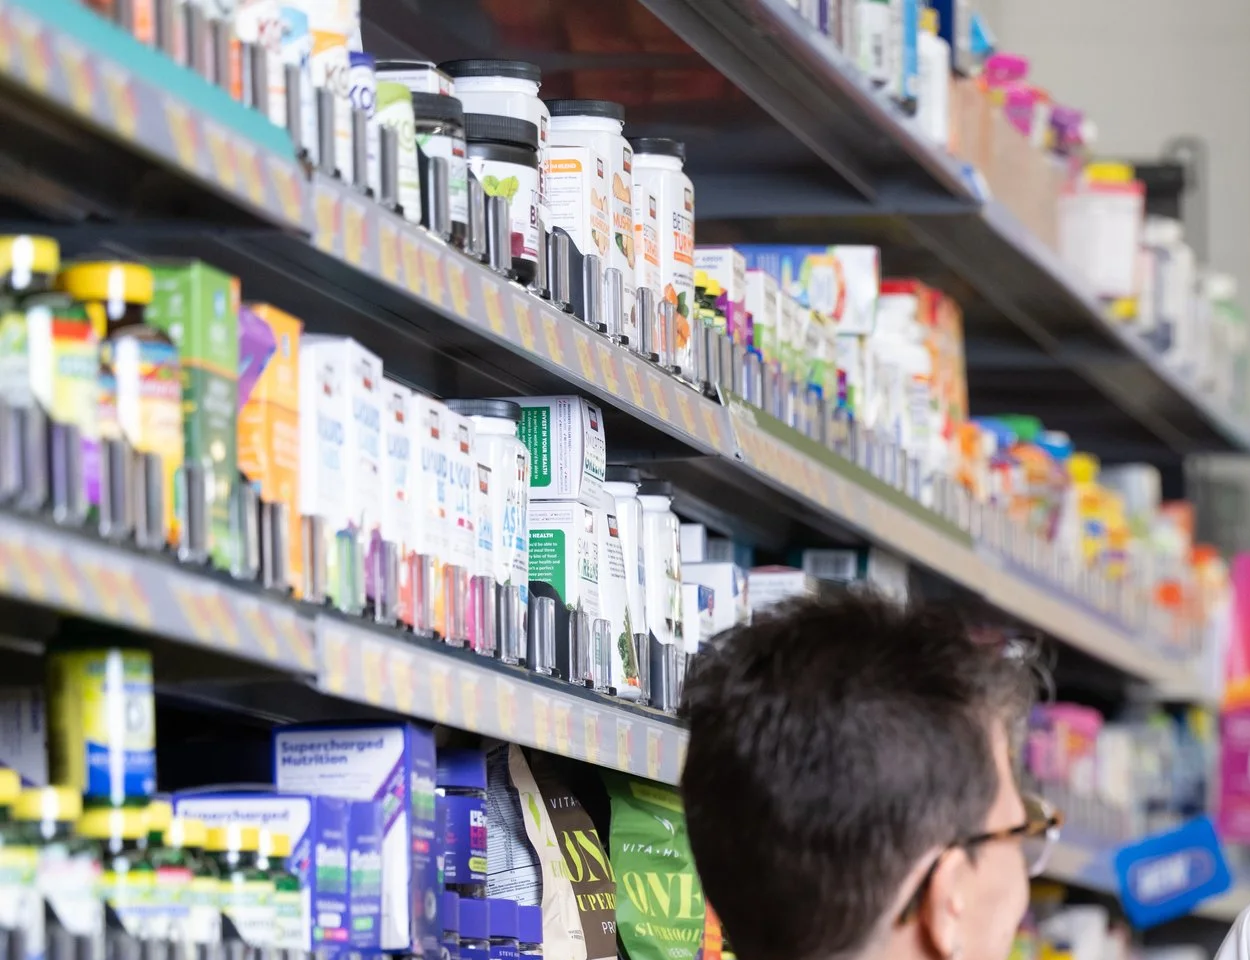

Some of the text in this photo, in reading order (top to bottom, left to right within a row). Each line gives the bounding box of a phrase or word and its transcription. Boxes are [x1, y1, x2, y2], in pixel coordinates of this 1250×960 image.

[281, 738, 384, 753] Supercharged
[282, 755, 348, 767] Nutrition
[622, 872, 706, 920] ONE
